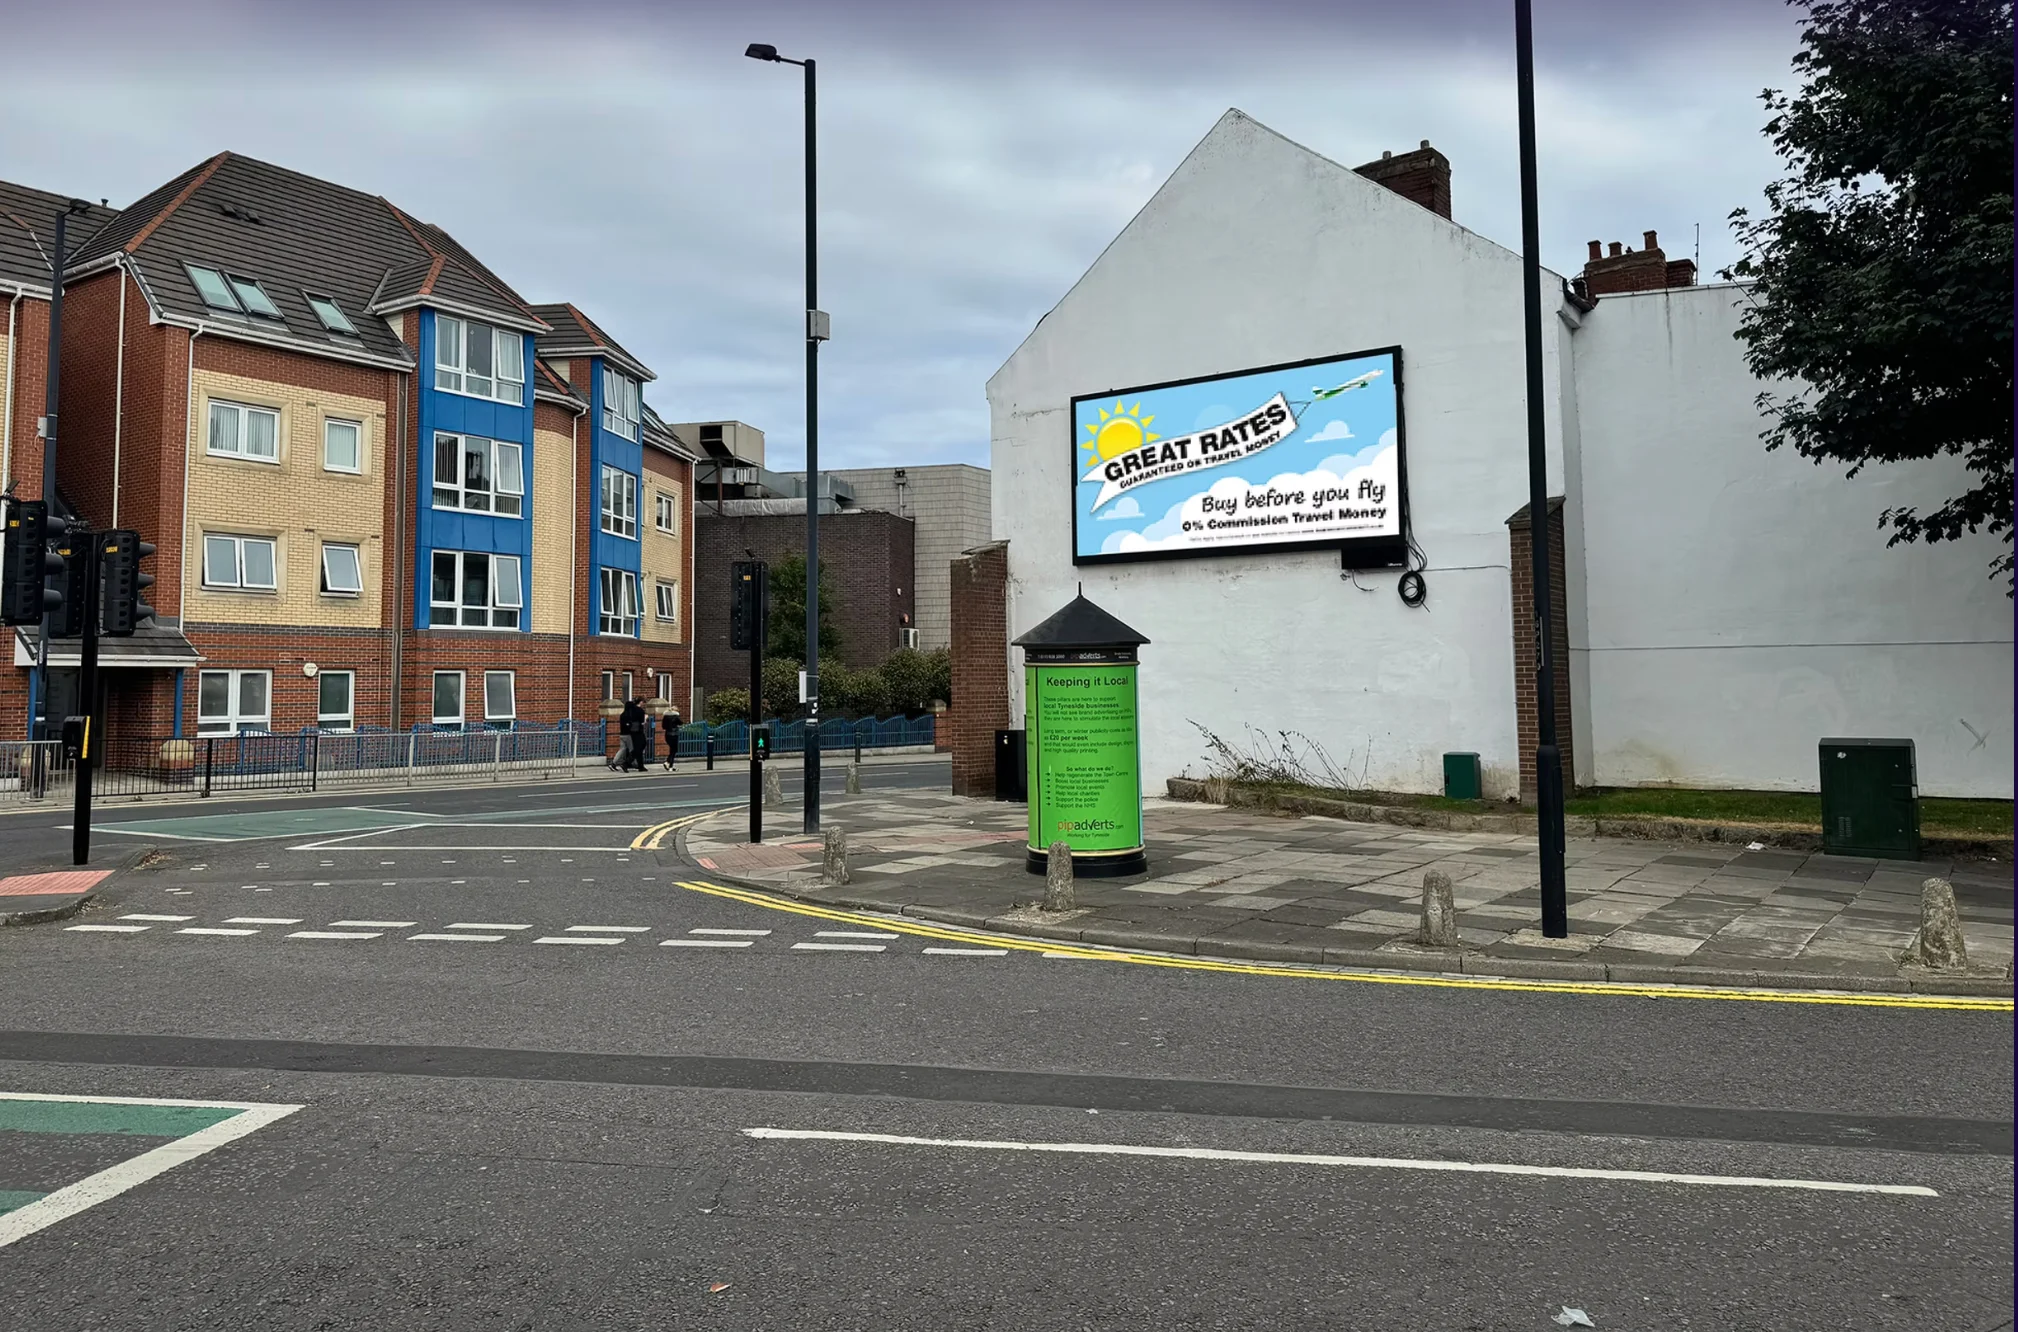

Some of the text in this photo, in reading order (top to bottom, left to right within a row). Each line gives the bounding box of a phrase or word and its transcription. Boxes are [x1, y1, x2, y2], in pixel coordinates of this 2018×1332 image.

[1105, 404, 1286, 481] GREAT RATES
[1120, 431, 1281, 489] GUARANTEED ON TRAVEL MONEY
[1202, 478, 1386, 516] Buy before you fly
[1182, 507, 1387, 532] 0% Commission Travel Money
[1046, 676, 1128, 688] Keeping it Local
